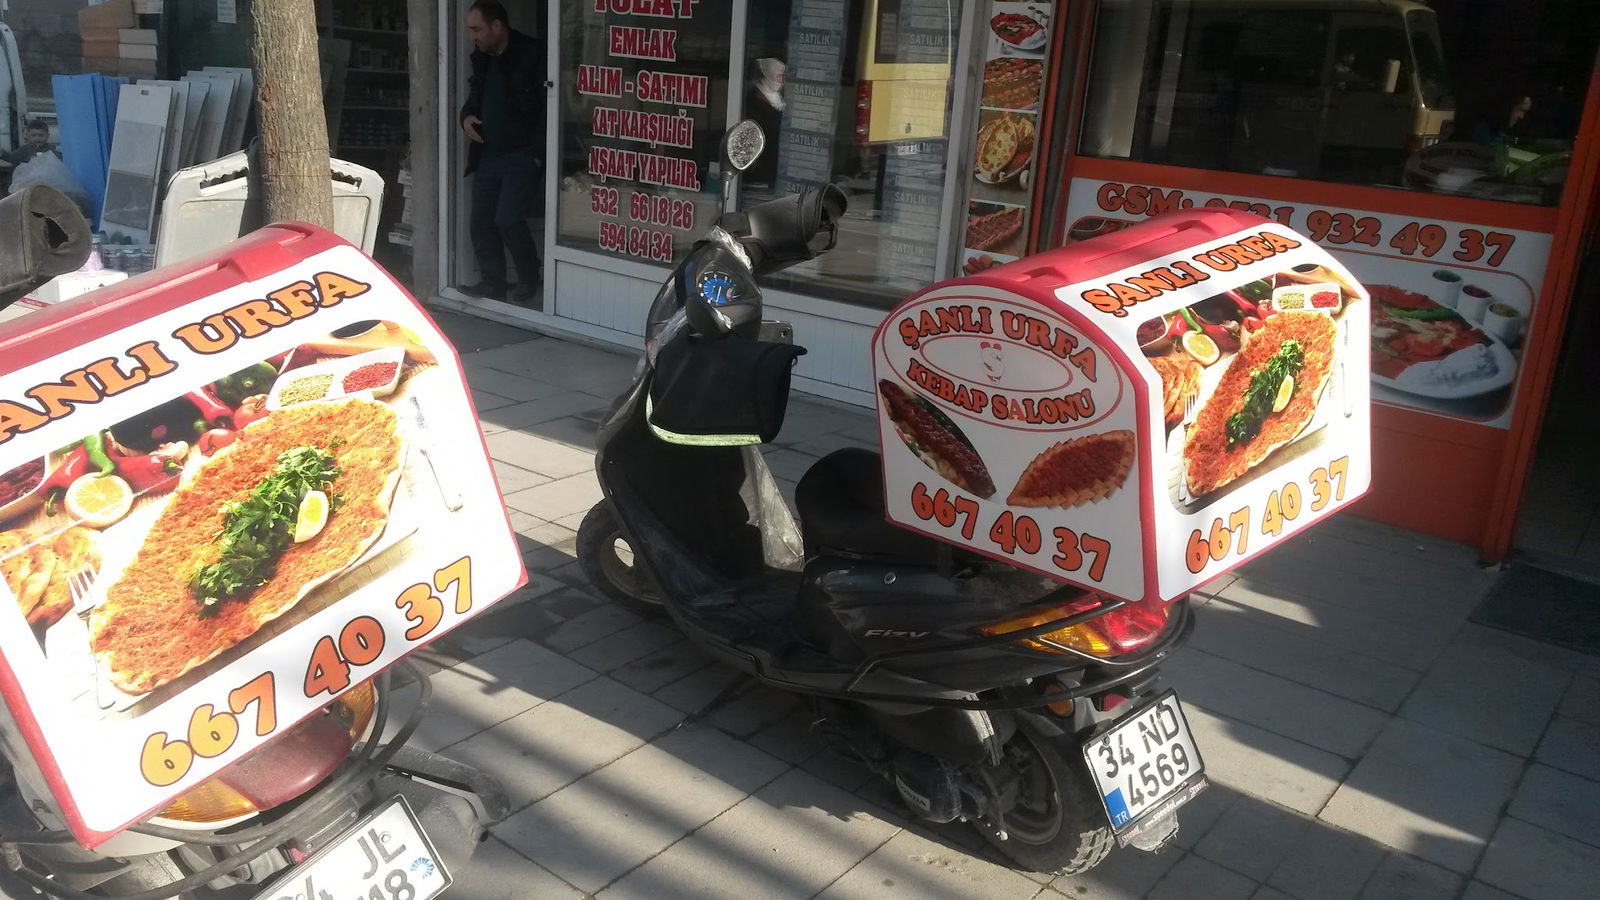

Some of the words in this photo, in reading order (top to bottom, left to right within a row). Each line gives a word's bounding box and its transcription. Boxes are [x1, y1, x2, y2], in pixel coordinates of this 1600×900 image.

[609, 25, 676, 62] EMLAK
[576, 64, 622, 98] ALIM
[636, 70, 708, 108] SATIMI
[592, 106, 619, 136] KAT
[619, 109, 694, 149] KARŞILIĞI
[637, 153, 700, 192] YAPILIR.
[591, 185, 619, 216] 532
[629, 192, 649, 223] 66
[651, 195, 669, 227] 18
[671, 199, 694, 231] 26
[1306, 209, 1382, 247] 932
[1390, 221, 1447, 258] 49
[1453, 229, 1516, 267] 37
[599, 221, 627, 251] 594
[628, 227, 649, 258] 84
[651, 231, 673, 263] 34
[1080, 260, 1211, 318] ŞANLI
[1198, 231, 1302, 273] URFA
[171, 270, 372, 355] URFA
[899, 305, 993, 350] ŞANLI
[1000, 310, 1097, 383] URFA
[906, 358, 988, 414] KEBAP
[991, 388, 1096, 424] SALONU
[911, 481, 979, 540] 667
[989, 510, 1042, 554] 40
[1052, 526, 1111, 582] 37
[1185, 505, 1250, 574] 667
[1261, 481, 1302, 537] 40
[1308, 455, 1349, 512] 37
[140, 670, 277, 787] 667
[304, 615, 386, 698] 40
[395, 555, 472, 642] 37
[1098, 733, 1135, 778] 34
[1138, 702, 1180, 754] ND
[1127, 743, 1189, 807] 4569
[1115, 811, 1130, 825] TR
[357, 828, 407, 880] JL
